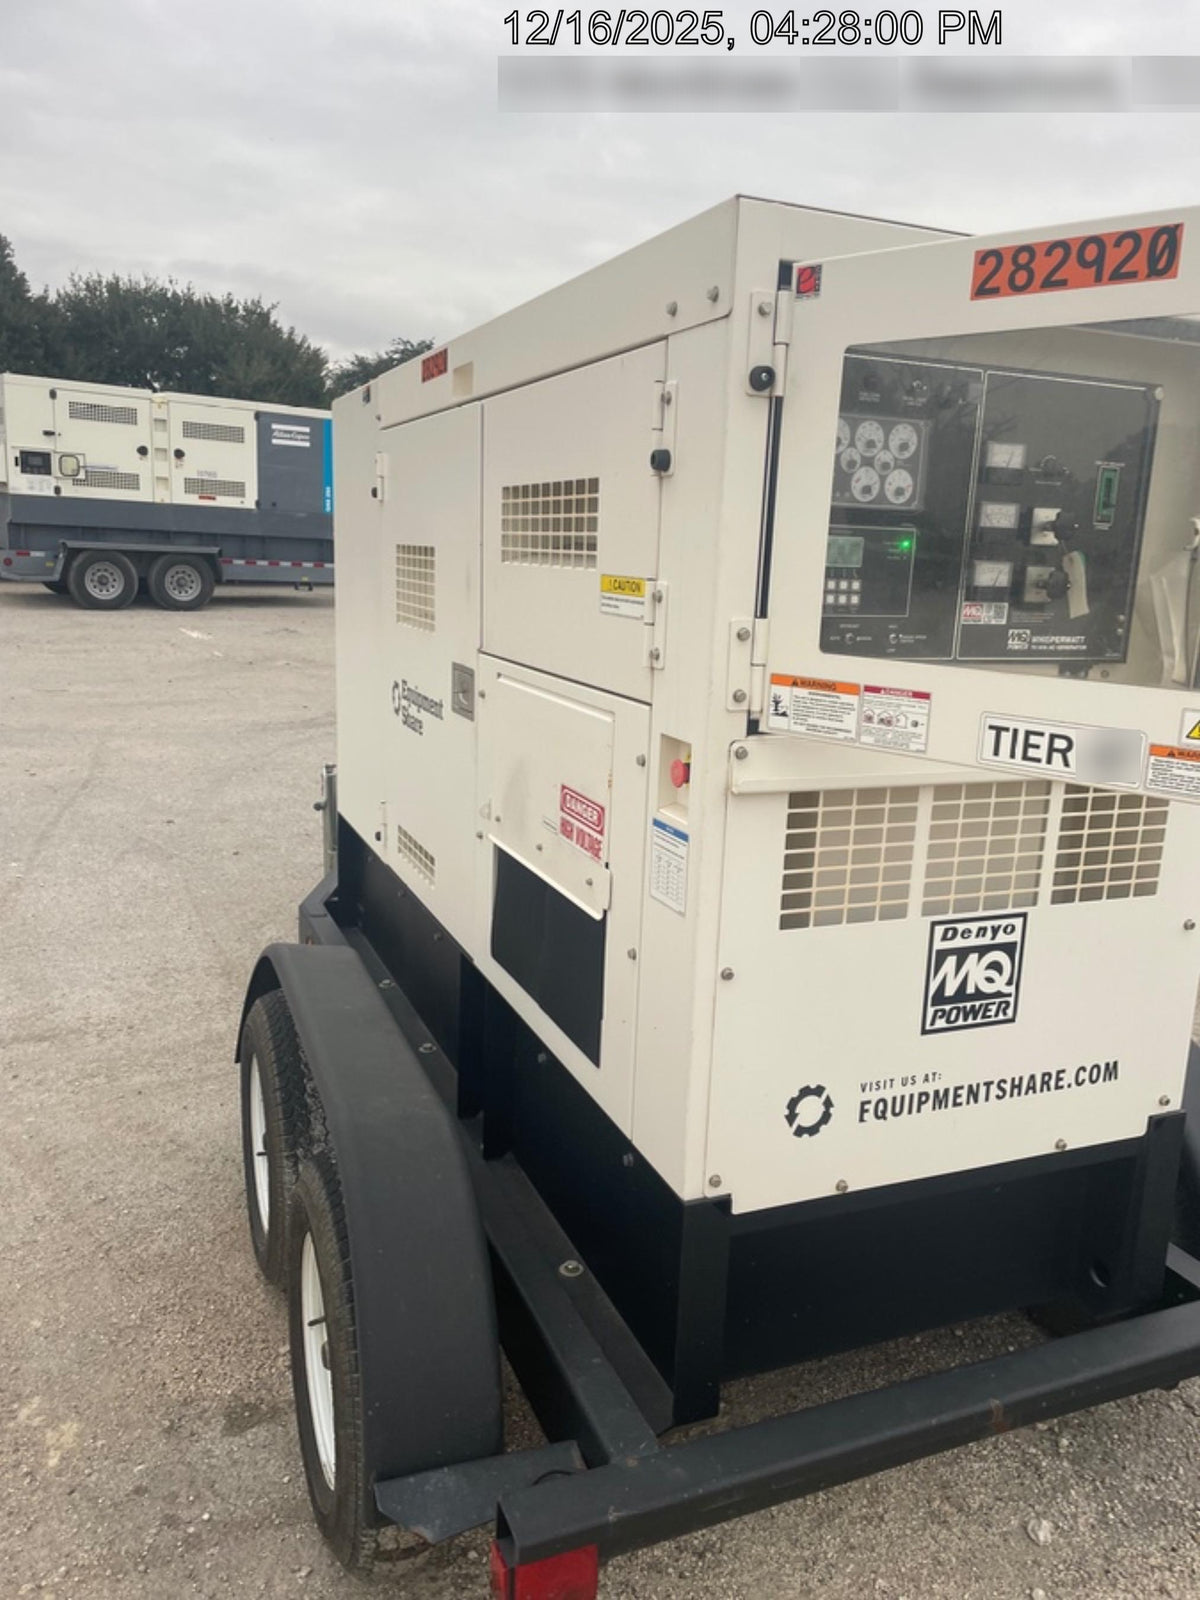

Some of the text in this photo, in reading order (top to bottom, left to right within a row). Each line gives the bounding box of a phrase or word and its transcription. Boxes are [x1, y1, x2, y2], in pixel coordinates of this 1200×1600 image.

[974, 224, 1181, 297] 282920
[613, 579, 641, 593] CAUTION
[988, 724, 1075, 768] TIER
[940, 923, 1016, 942] Denyo
[931, 950, 1013, 997] MQ
[929, 1000, 1011, 1027] POWER
[860, 1071, 942, 1093] VISIT US AT:
